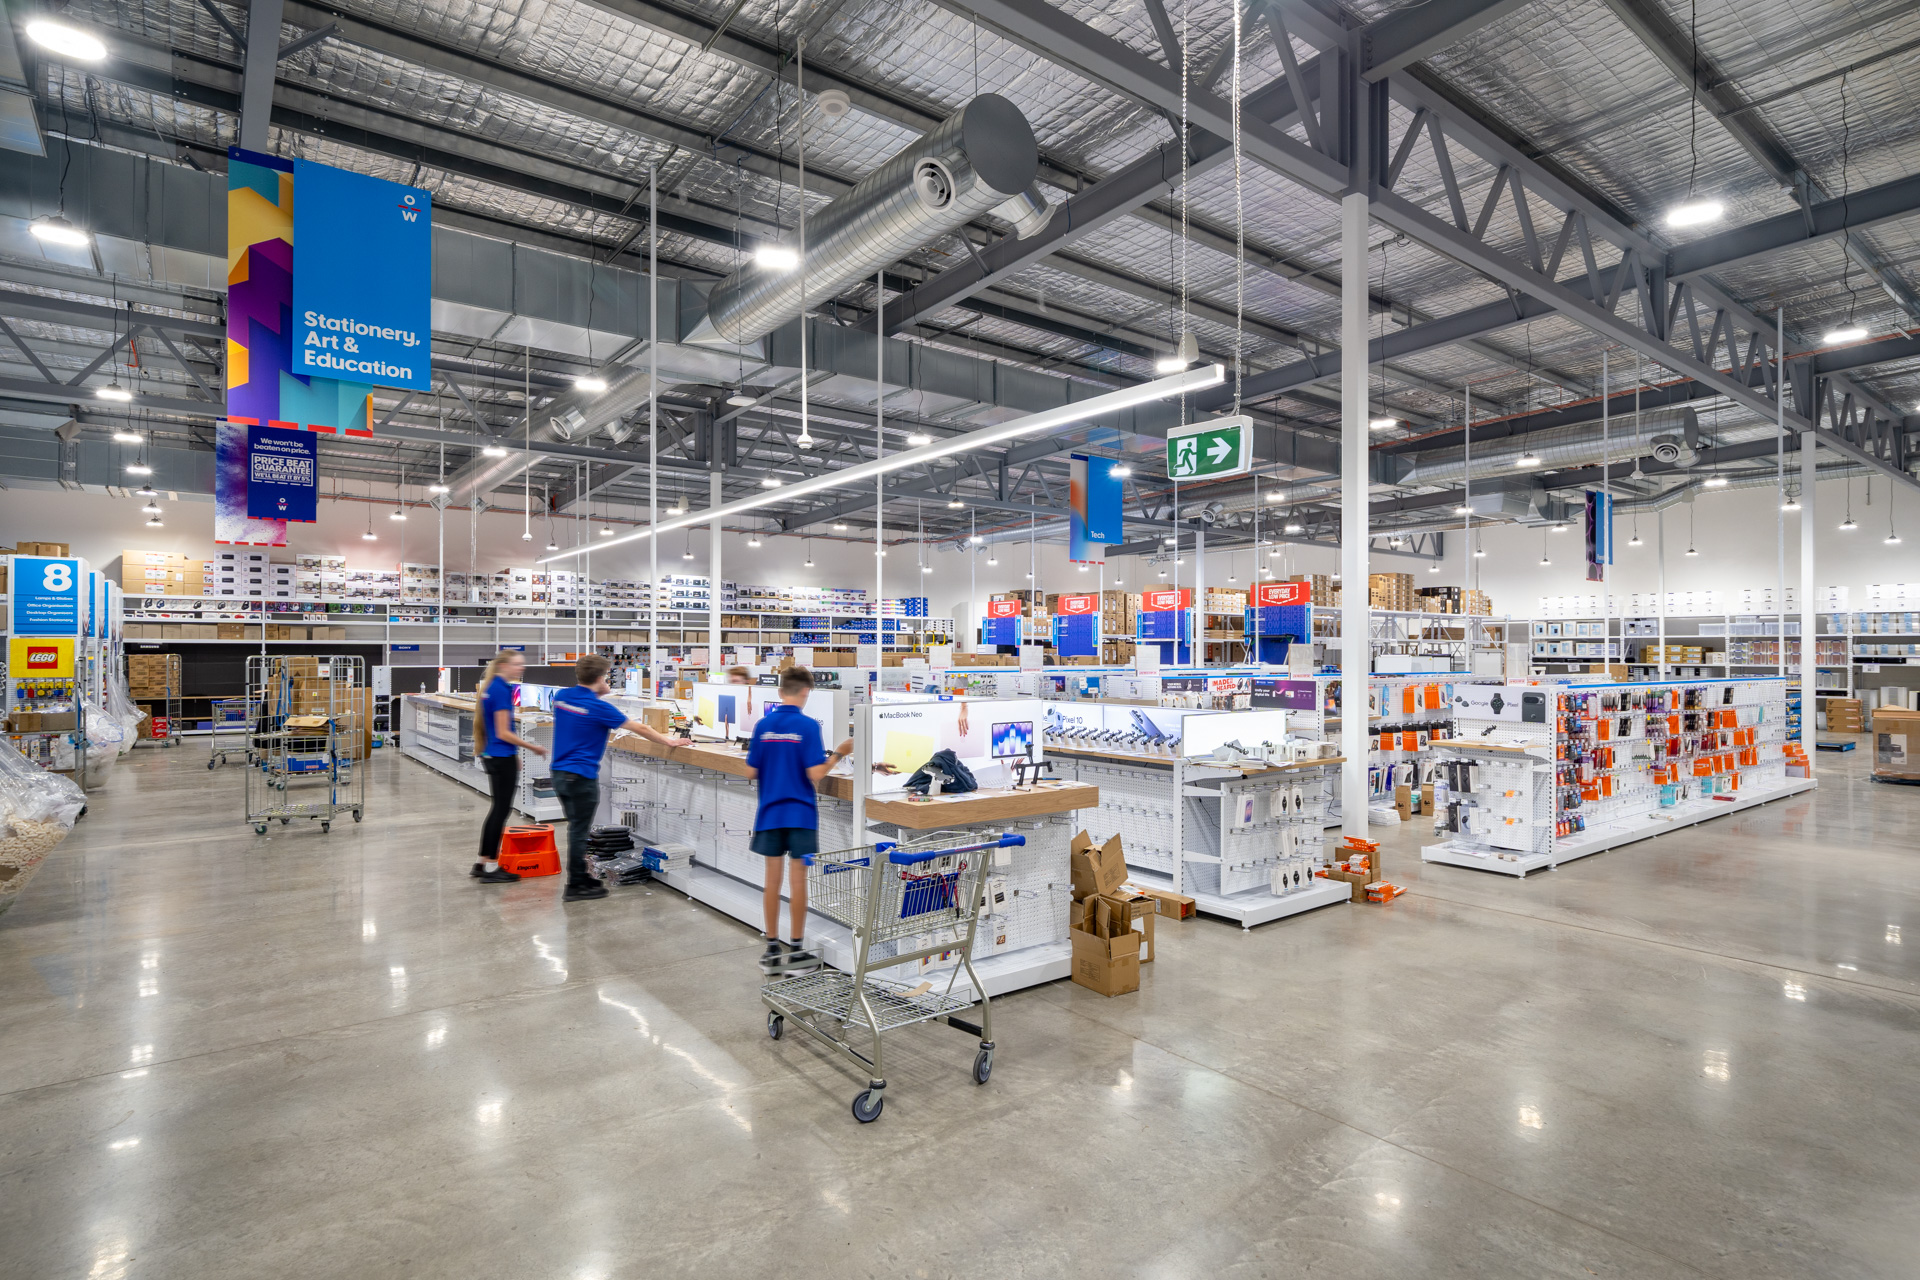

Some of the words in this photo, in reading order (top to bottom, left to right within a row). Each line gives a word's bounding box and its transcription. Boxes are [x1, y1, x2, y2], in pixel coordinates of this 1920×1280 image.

[304, 310, 420, 346] Stationery,
[304, 331, 339, 350] Art
[343, 336, 359, 354] &
[304, 350, 412, 380] Education
[254, 444, 280, 452] beaten
[254, 456, 284, 466] PRICE
[286, 459, 310, 468] BEAT
[254, 464, 310, 474] GUARANTEE
[1090, 530, 1105, 539] Tech
[42, 563, 72, 592] 8
[29, 653, 56, 662] LEGO
